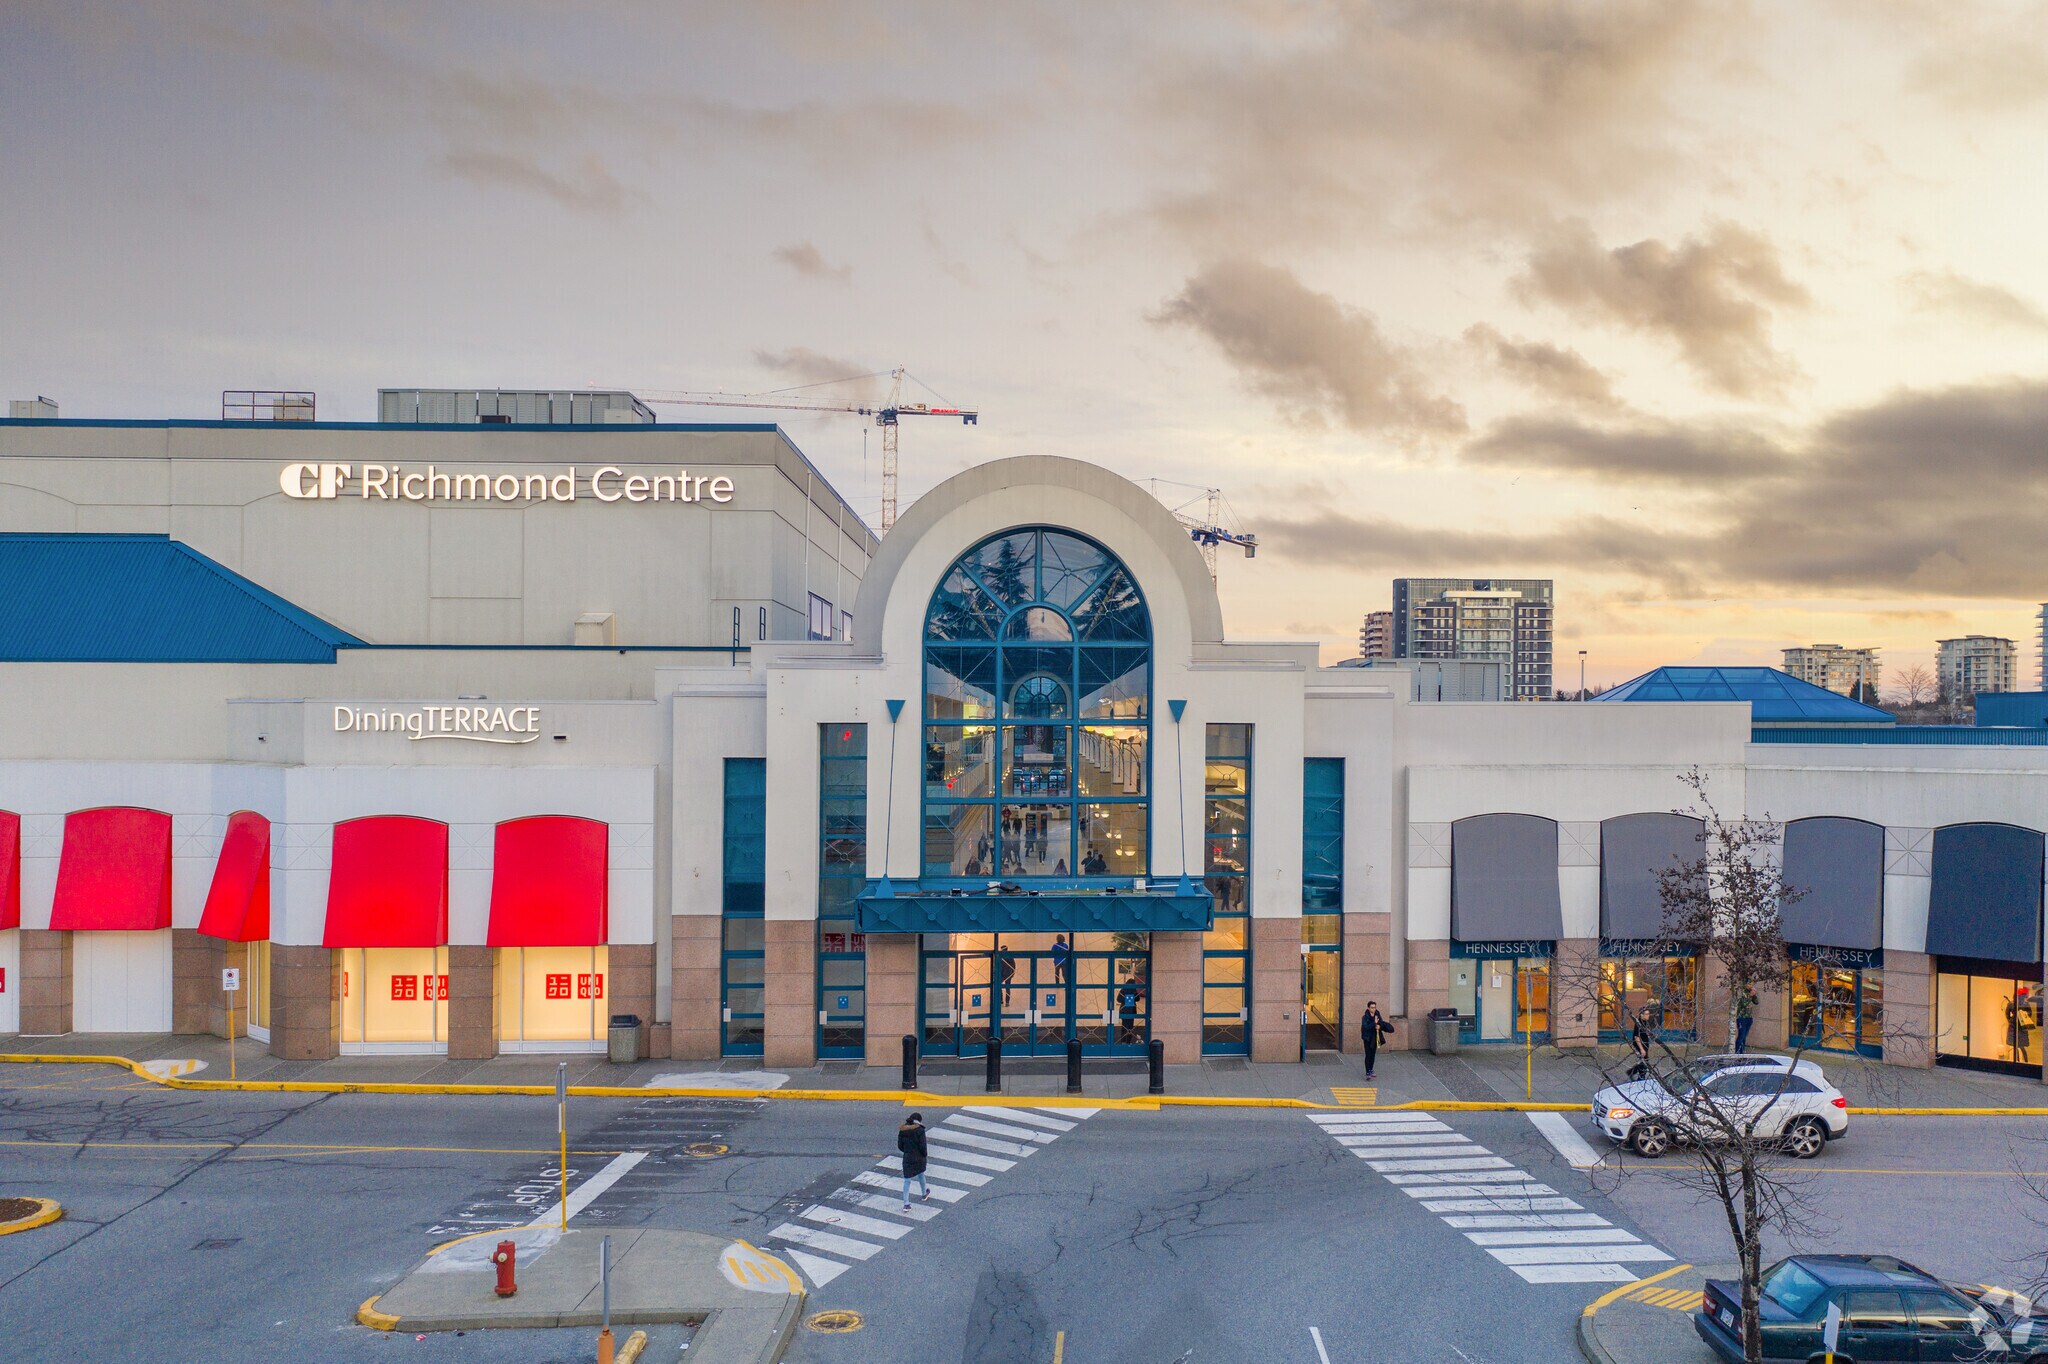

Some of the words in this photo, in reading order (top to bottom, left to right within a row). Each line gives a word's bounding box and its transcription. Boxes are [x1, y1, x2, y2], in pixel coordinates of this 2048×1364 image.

[280, 464, 352, 498] CF
[362, 465, 575, 501] Richmond
[592, 466, 734, 502] Centre
[1466, 942, 1534, 953] HENNESSEY
[507, 1168, 579, 1204] STOP
